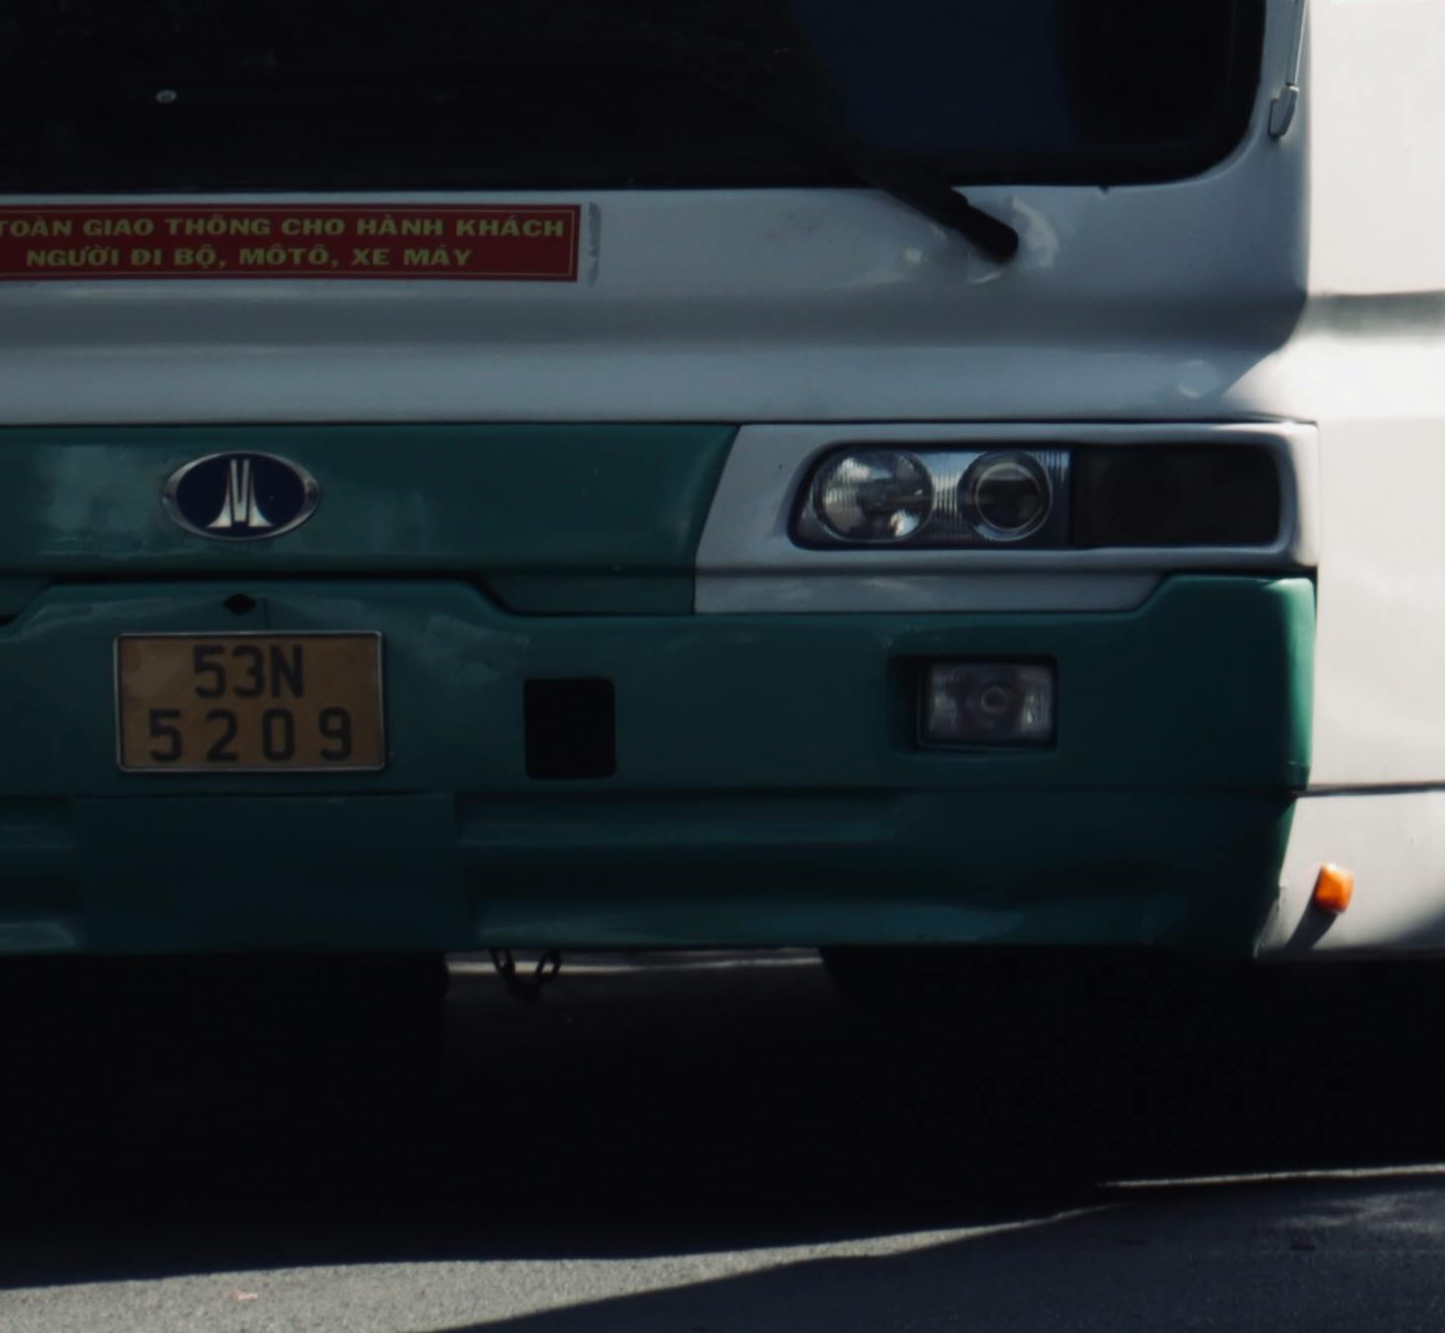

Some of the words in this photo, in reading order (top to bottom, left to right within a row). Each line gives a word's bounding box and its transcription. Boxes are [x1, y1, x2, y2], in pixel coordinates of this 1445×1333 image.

[82, 218, 156, 237] GIAO
[164, 213, 272, 237] THÔNG
[280, 217, 346, 236] CHO
[356, 213, 444, 237] HÀNH
[455, 214, 565, 238] KHÁCH
[26, 245, 119, 267] NGƯỜI
[130, 248, 163, 266] ĐI
[173, 244, 228, 269] BỘ,
[238, 243, 340, 269] MÔTÔ,
[350, 248, 391, 266] XE
[402, 244, 474, 266] MÁY
[191, 643, 305, 700] 53N
[148, 707, 353, 763] 5209
